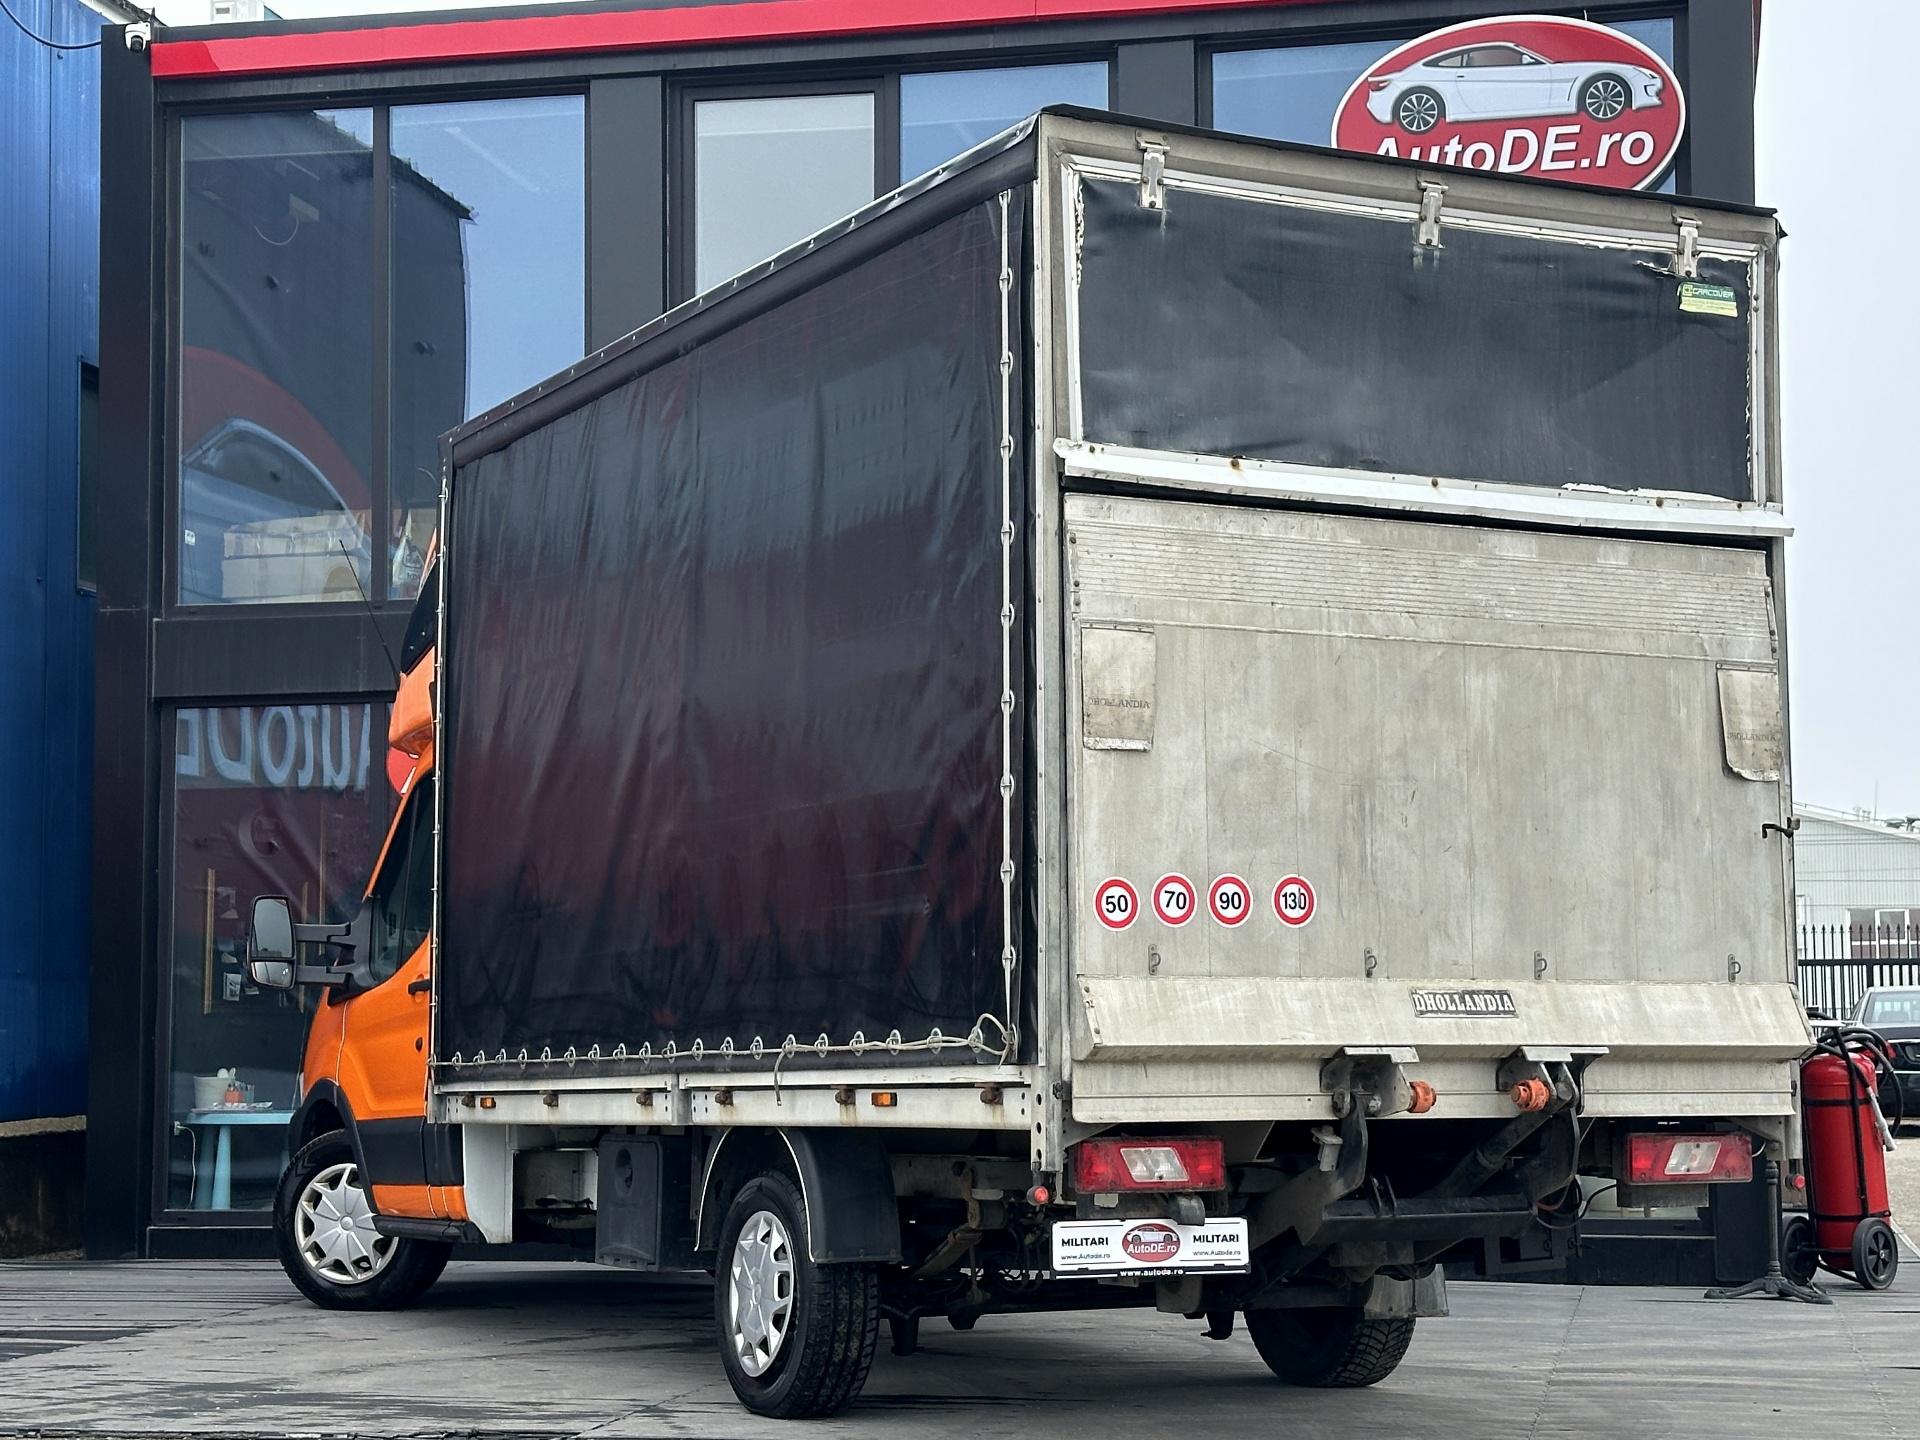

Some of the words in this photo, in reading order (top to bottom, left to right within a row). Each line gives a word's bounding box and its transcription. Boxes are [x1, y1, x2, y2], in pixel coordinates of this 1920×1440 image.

[1105, 894, 1129, 914] 50
[1163, 890, 1187, 910] 70
[1219, 891, 1242, 910] 90
[1281, 891, 1307, 910] 130
[1412, 993, 1515, 1011] DHOLLANDIA
[1061, 1236, 1109, 1247] MILITARI
[1193, 1234, 1239, 1243] MILITARI
[1126, 1242, 1177, 1254] AutoDE.ro
[1120, 1268, 1184, 1277] www.autode.ro
